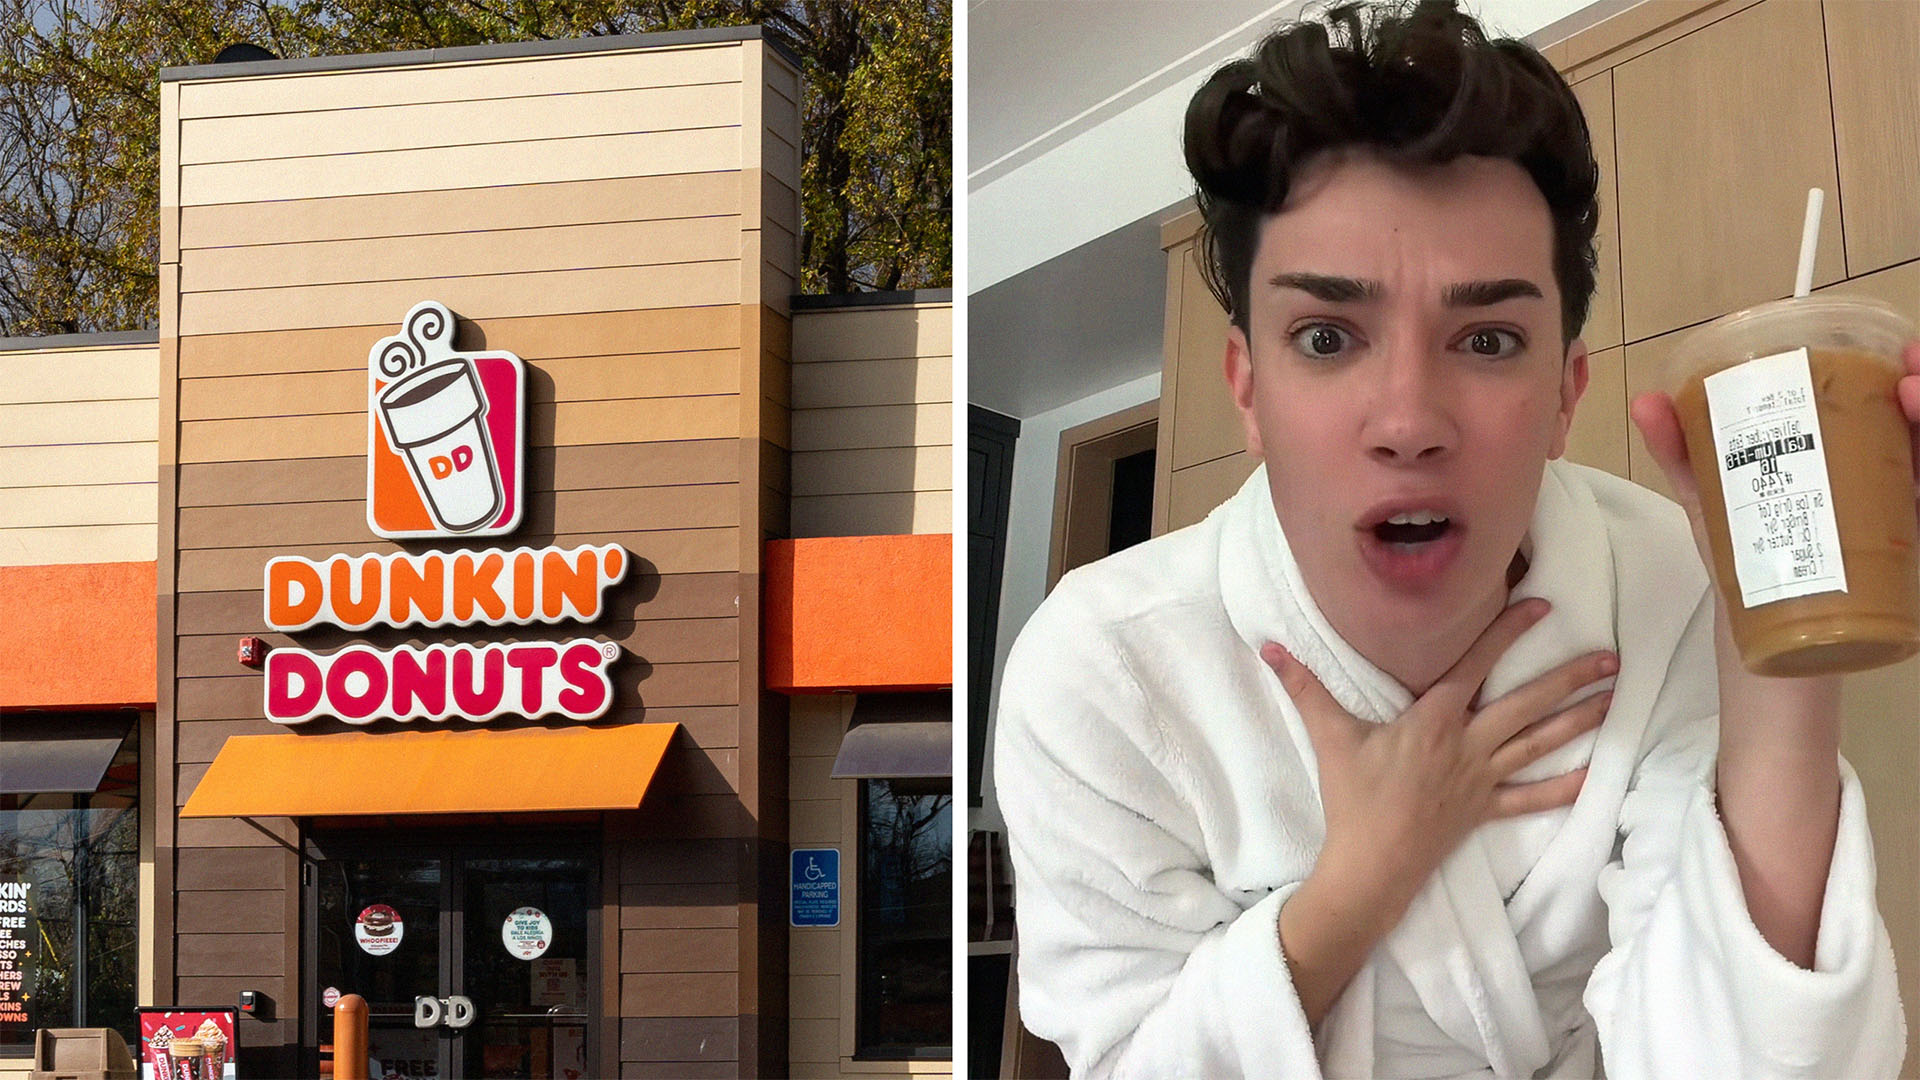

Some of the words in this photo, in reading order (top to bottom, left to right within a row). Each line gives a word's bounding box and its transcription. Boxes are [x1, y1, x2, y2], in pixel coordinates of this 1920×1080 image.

[428, 445, 473, 480] DD
[269, 548, 623, 626] DUNKIN'
[269, 644, 606, 718] DONUTS
[794, 882, 837, 890] HANDICAPPED
[801, 890, 829, 899] PARKING
